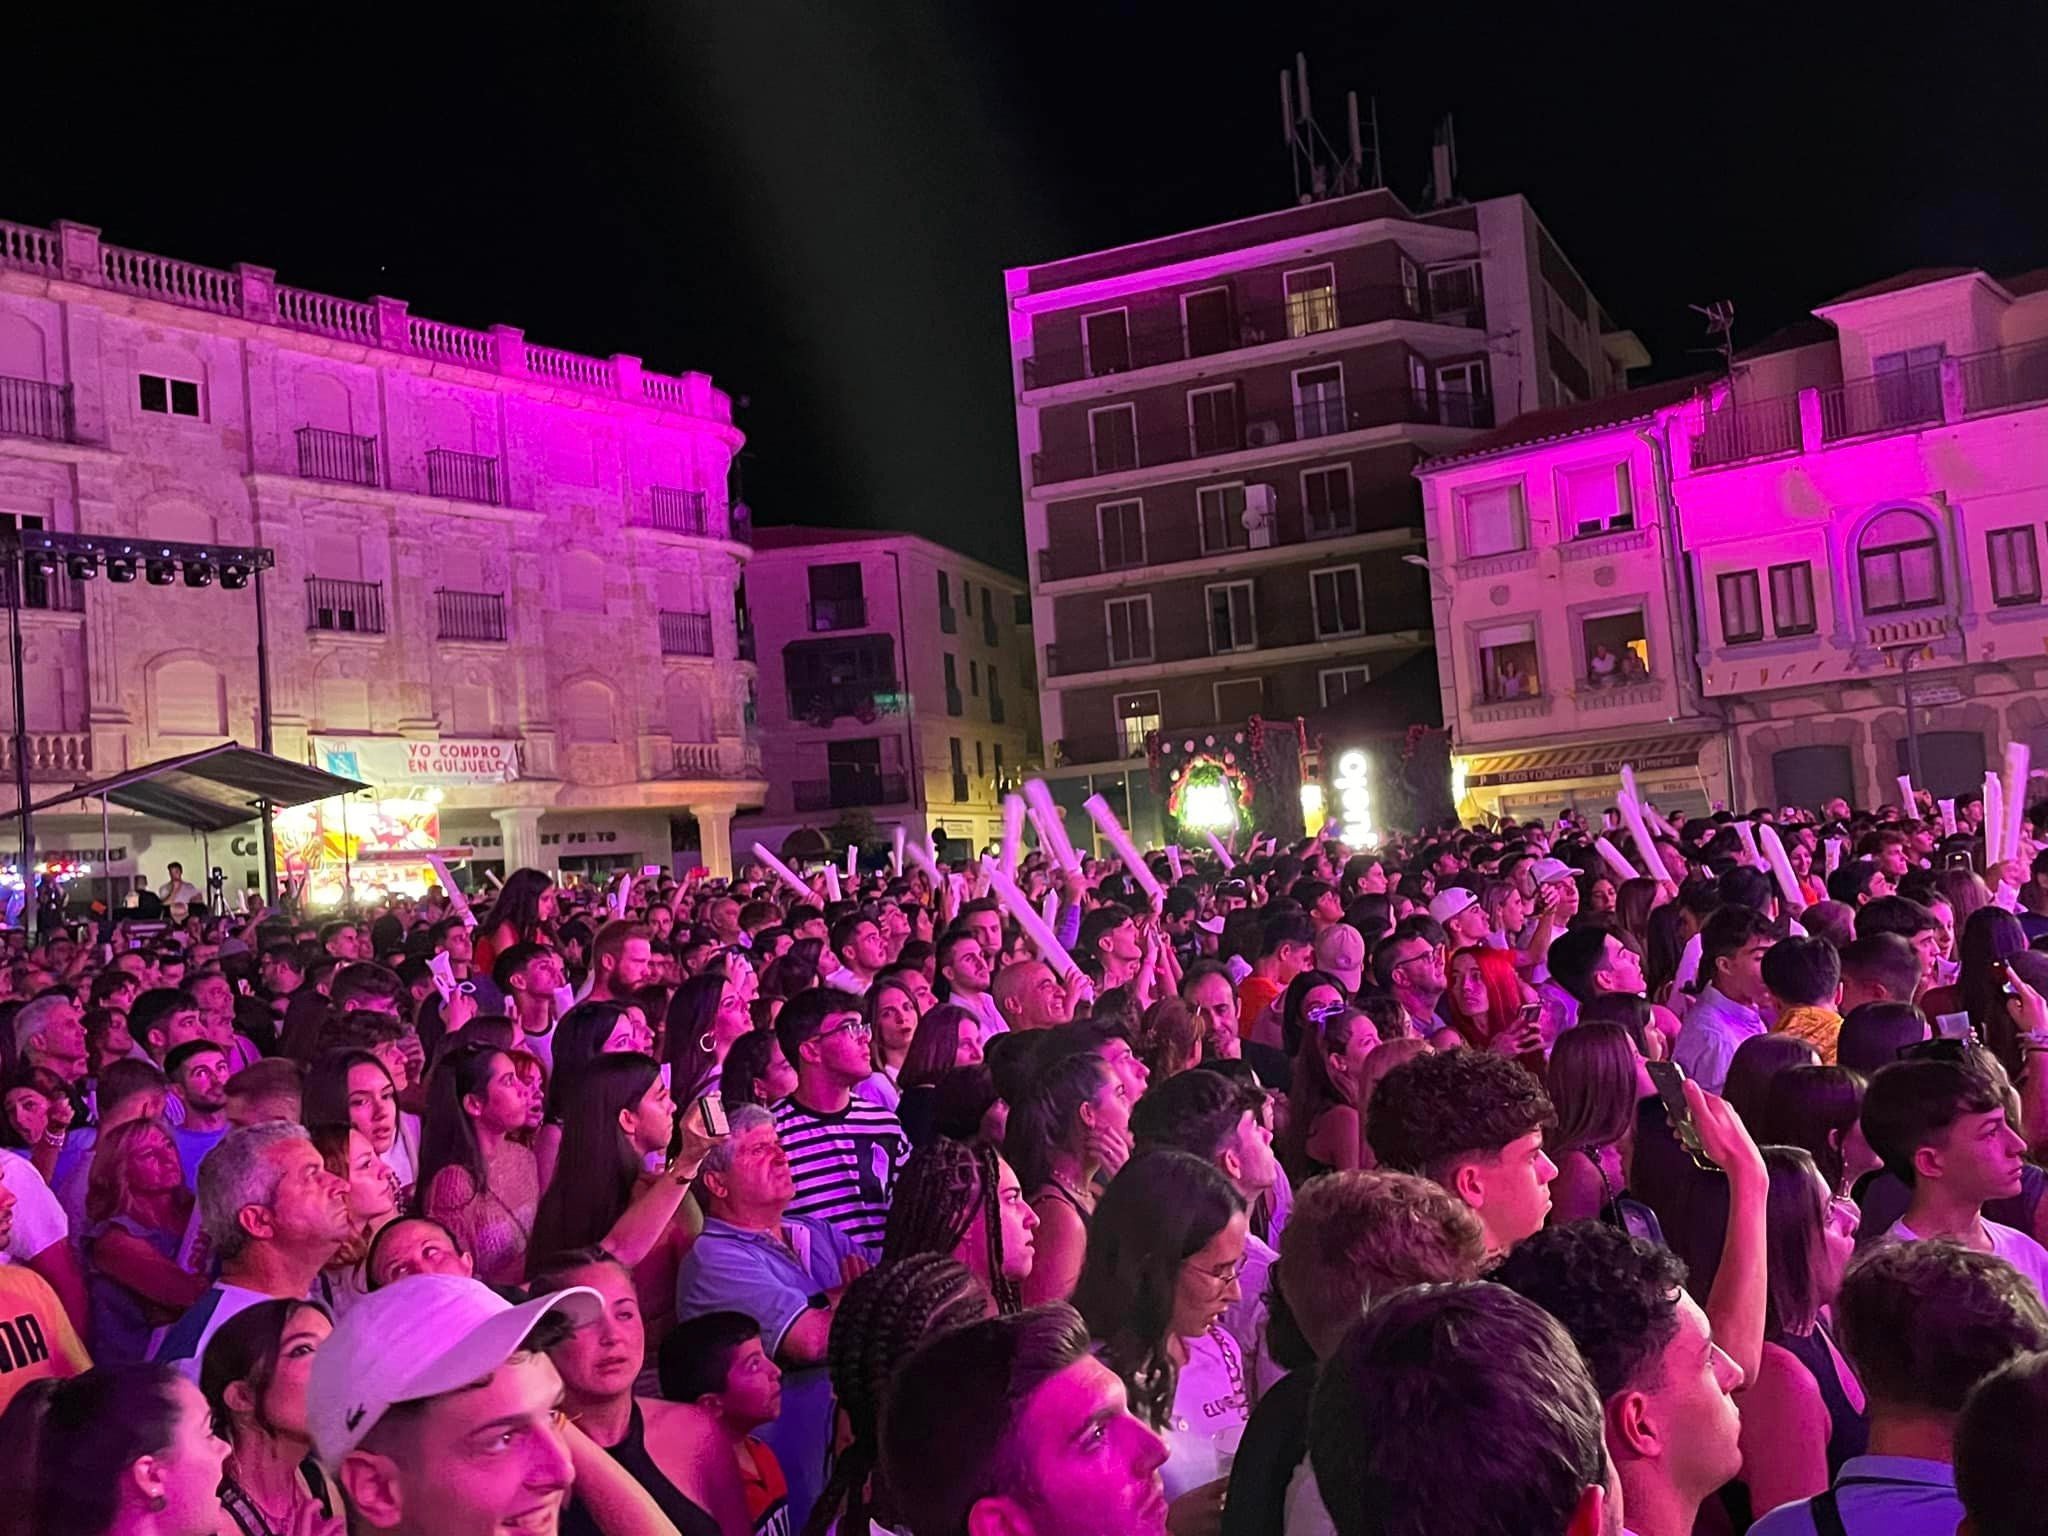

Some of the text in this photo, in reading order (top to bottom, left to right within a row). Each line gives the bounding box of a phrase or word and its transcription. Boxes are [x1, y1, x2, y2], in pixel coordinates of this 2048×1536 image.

[408, 743, 501, 759] YO COMPRO
[408, 759, 507, 773] EN GUIJUELO
